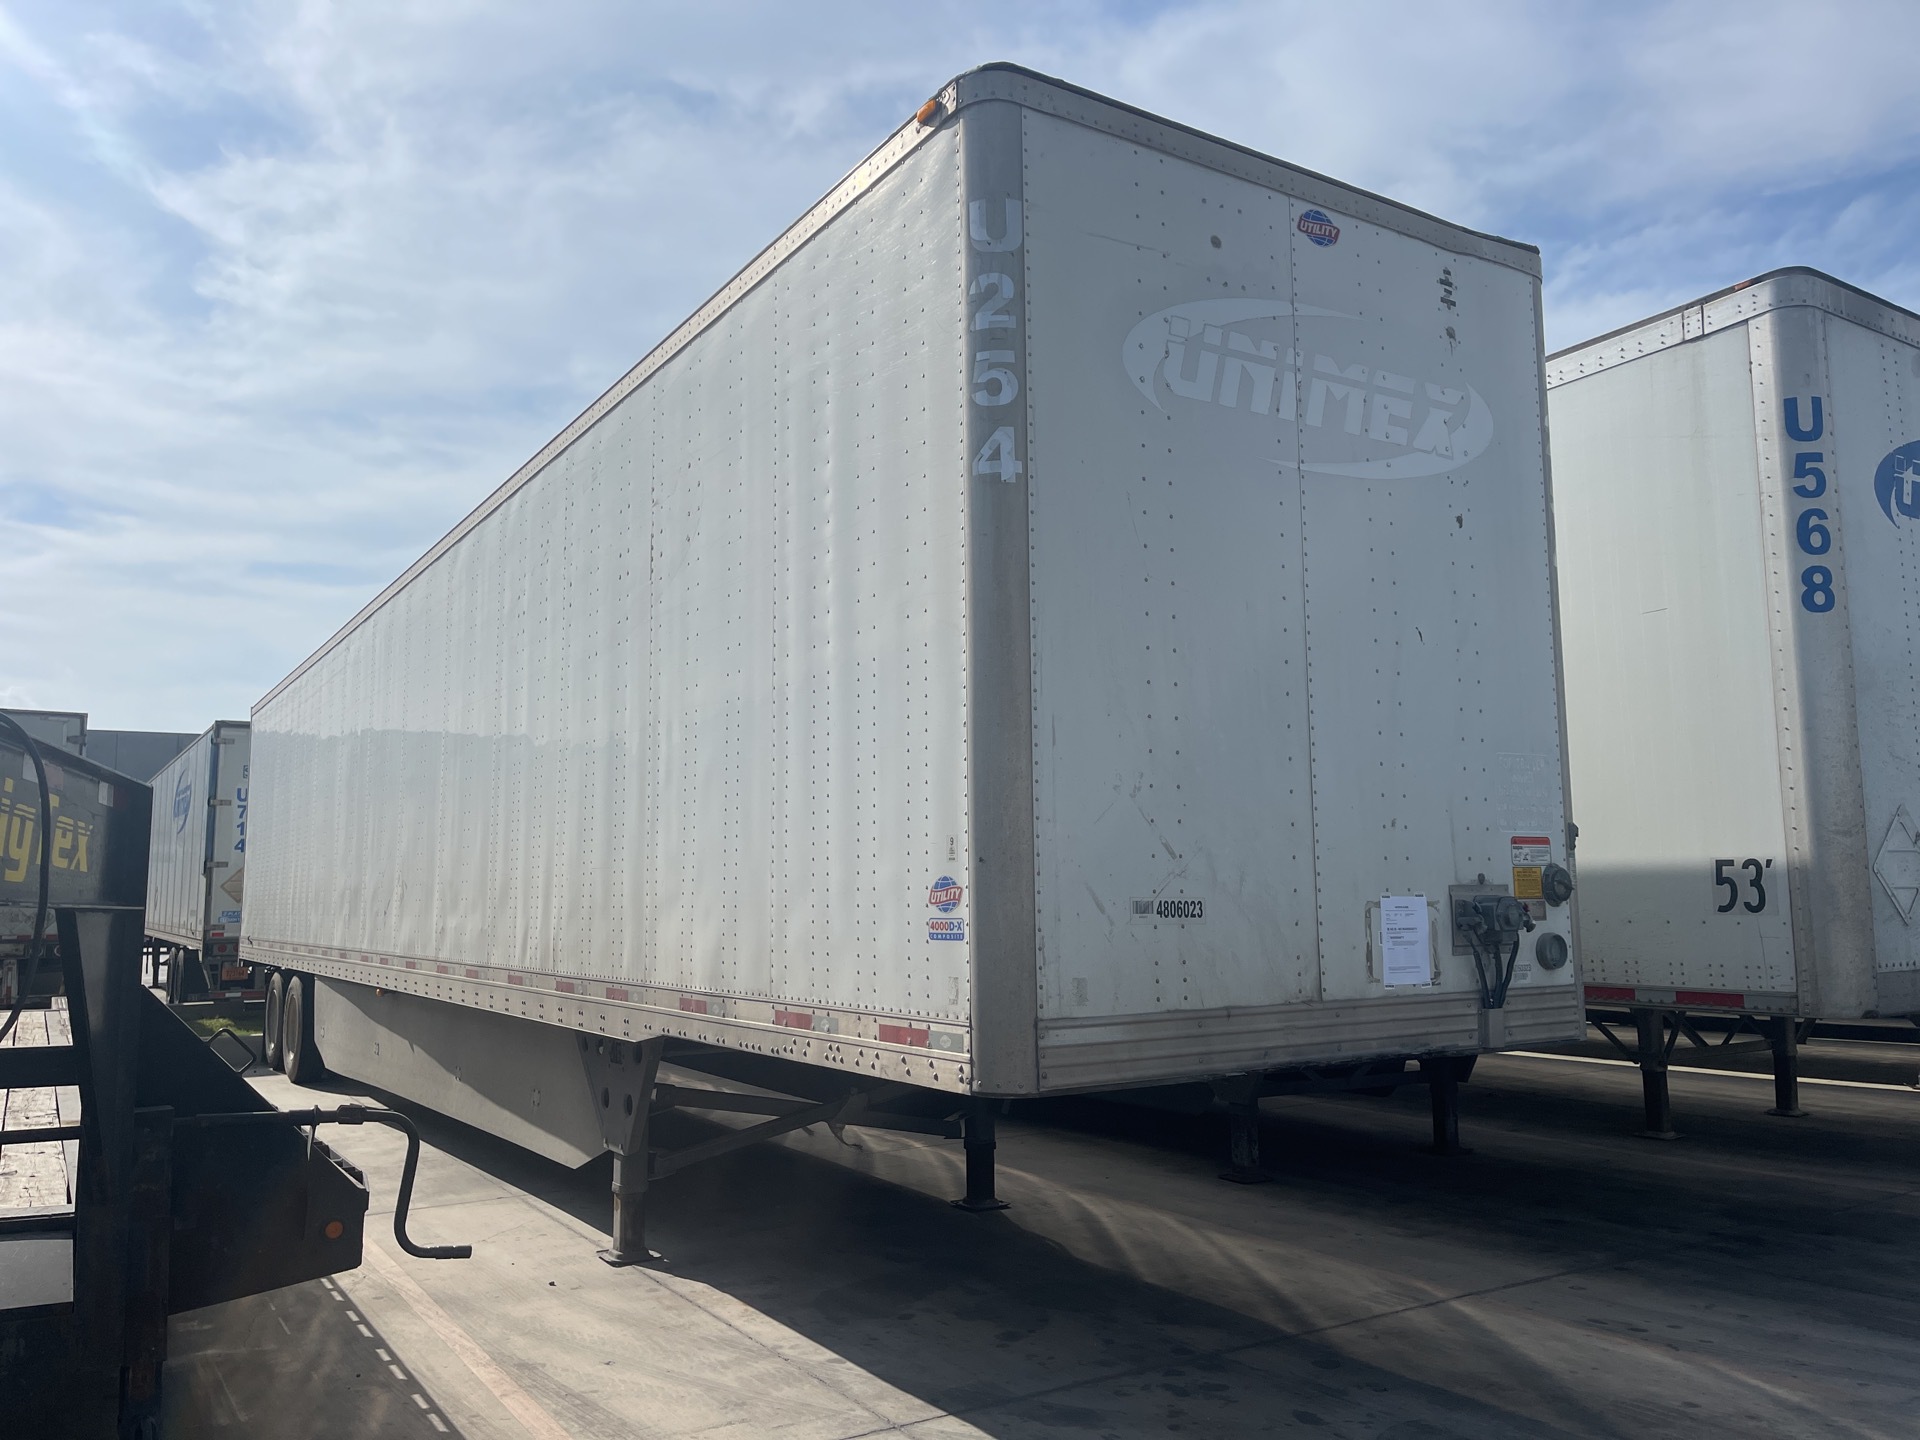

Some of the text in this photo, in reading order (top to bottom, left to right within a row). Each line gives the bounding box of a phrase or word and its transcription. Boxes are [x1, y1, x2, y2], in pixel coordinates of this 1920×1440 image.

[1300, 220, 1338, 238] UTILITY
[968, 198, 1024, 484] U254
[1163, 314, 1466, 460] UNIMEX
[1783, 396, 1836, 613] U568
[233, 787, 249, 853] U714
[930, 888, 962, 904] UTILITY
[1156, 900, 1204, 919] 4806023
[1715, 858, 1773, 914] 53'
[930, 921, 963, 932] 4000D-X
